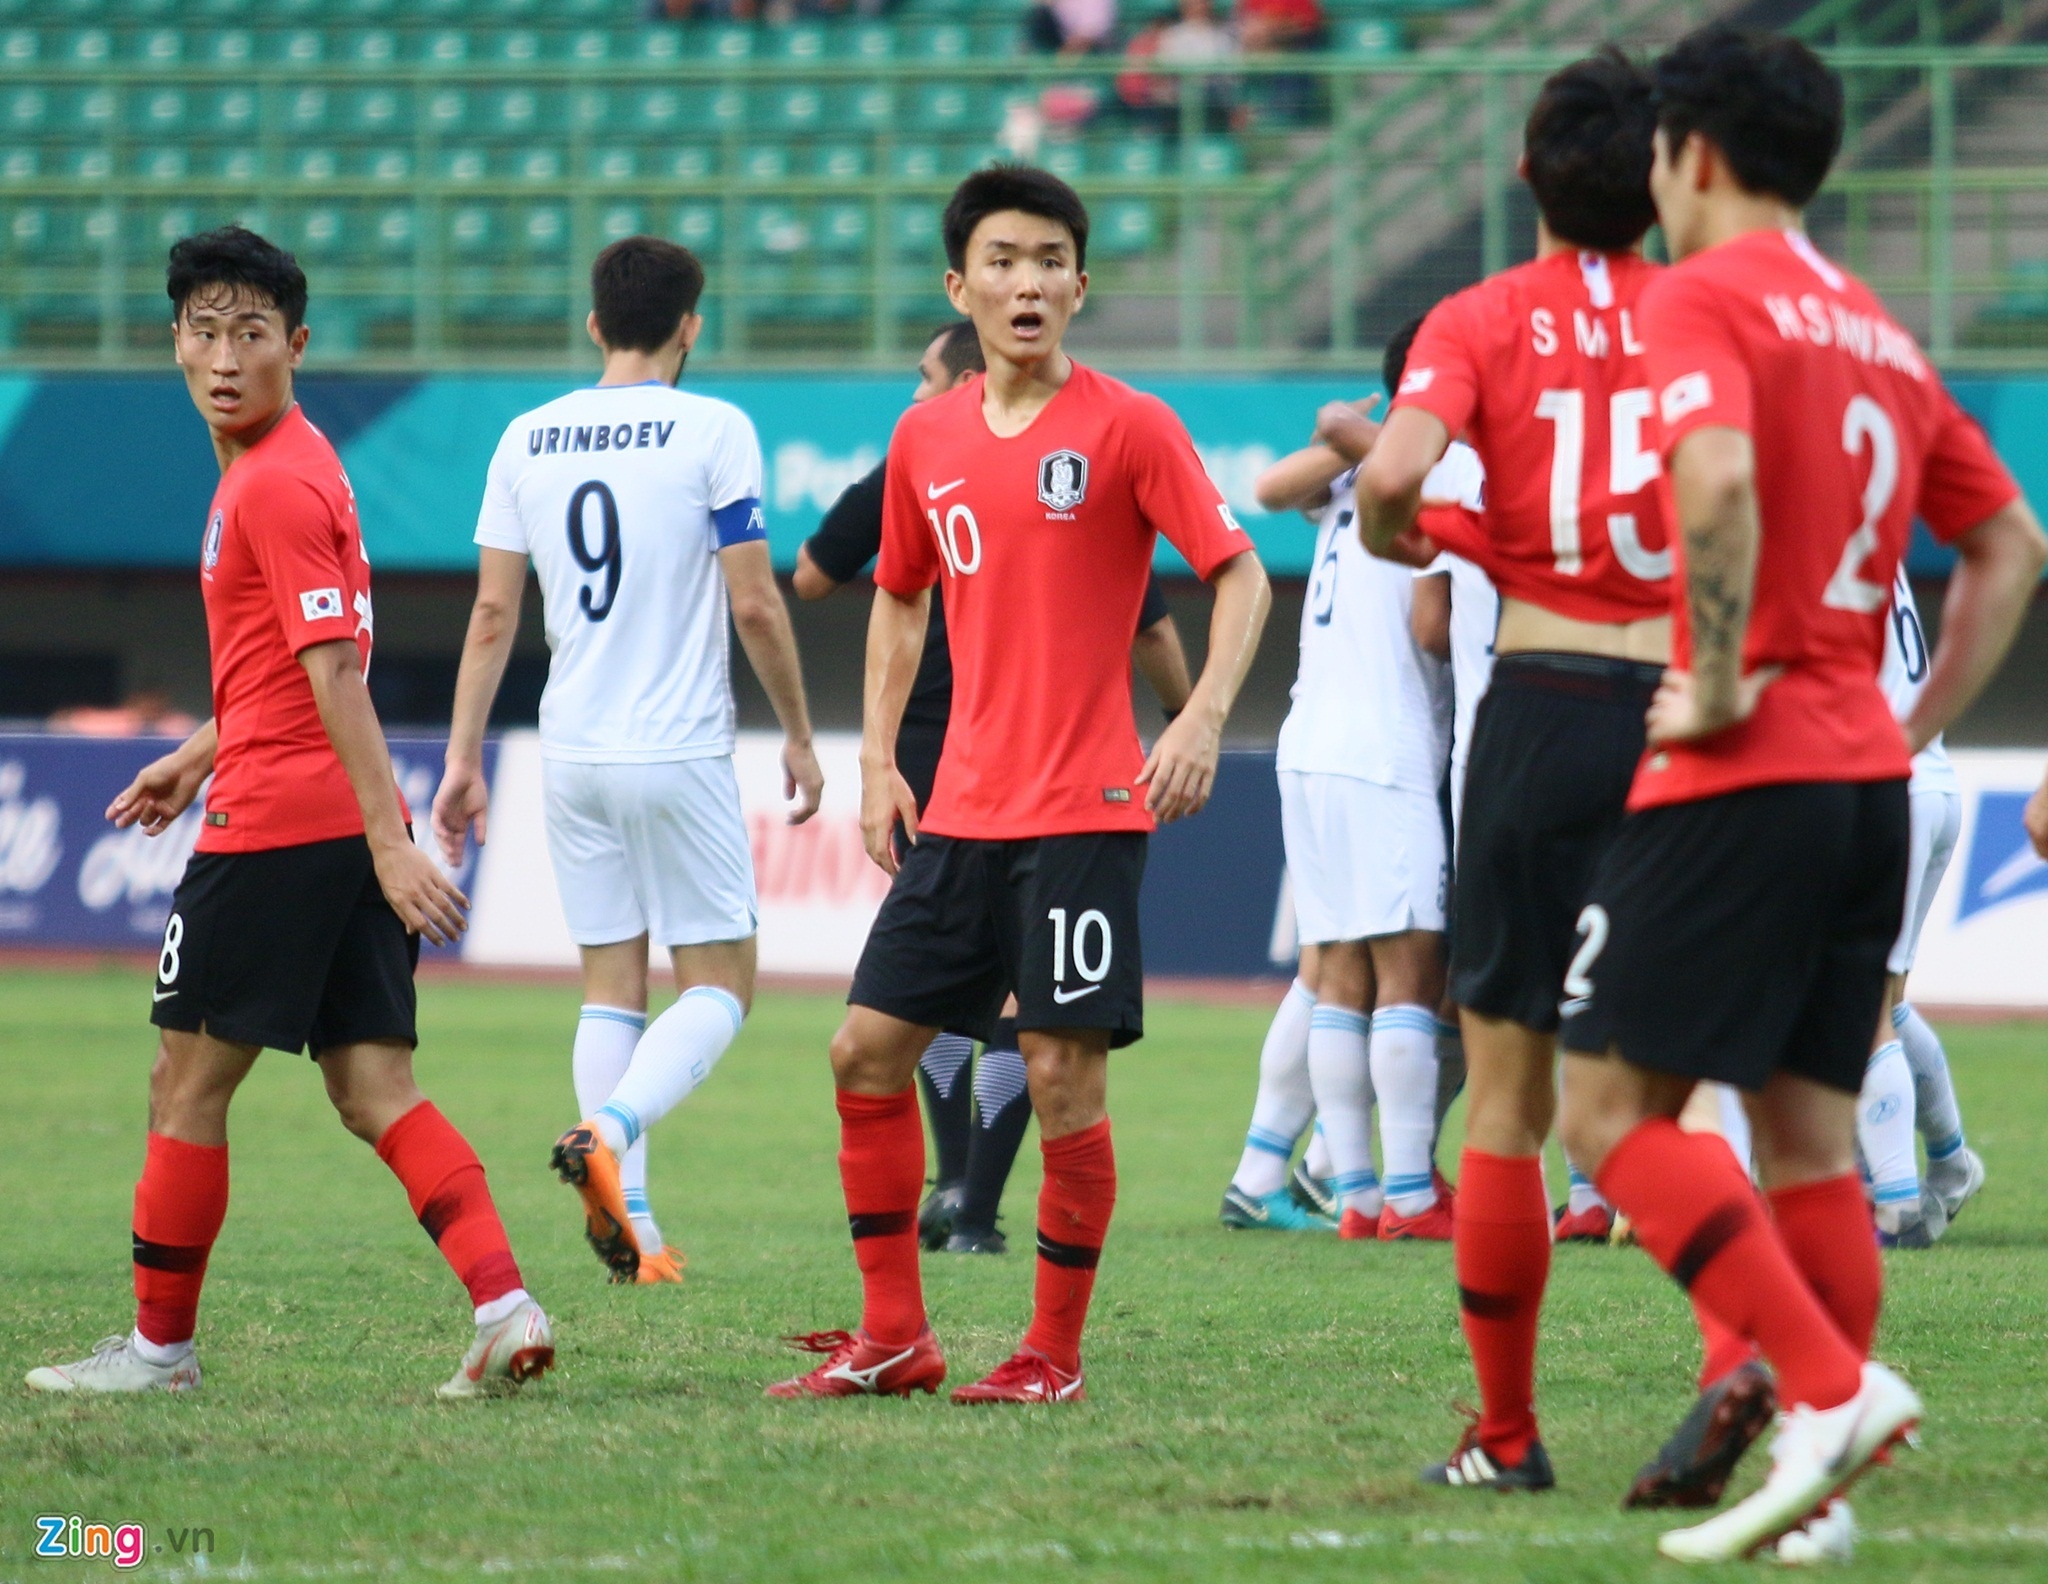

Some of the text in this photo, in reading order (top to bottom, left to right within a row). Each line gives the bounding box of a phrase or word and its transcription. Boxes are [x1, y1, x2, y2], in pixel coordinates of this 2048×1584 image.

[527, 420, 676, 457] URINBOEV
[1045, 512, 1076, 521] KOREA
[1533, 386, 1675, 582] 15
[1820, 394, 1898, 613] 2
[565, 479, 622, 623] 9
[927, 503, 981, 578] 10
[159, 912, 184, 985] 8
[1048, 908, 1112, 982] 10
[1563, 903, 1610, 997] 2
